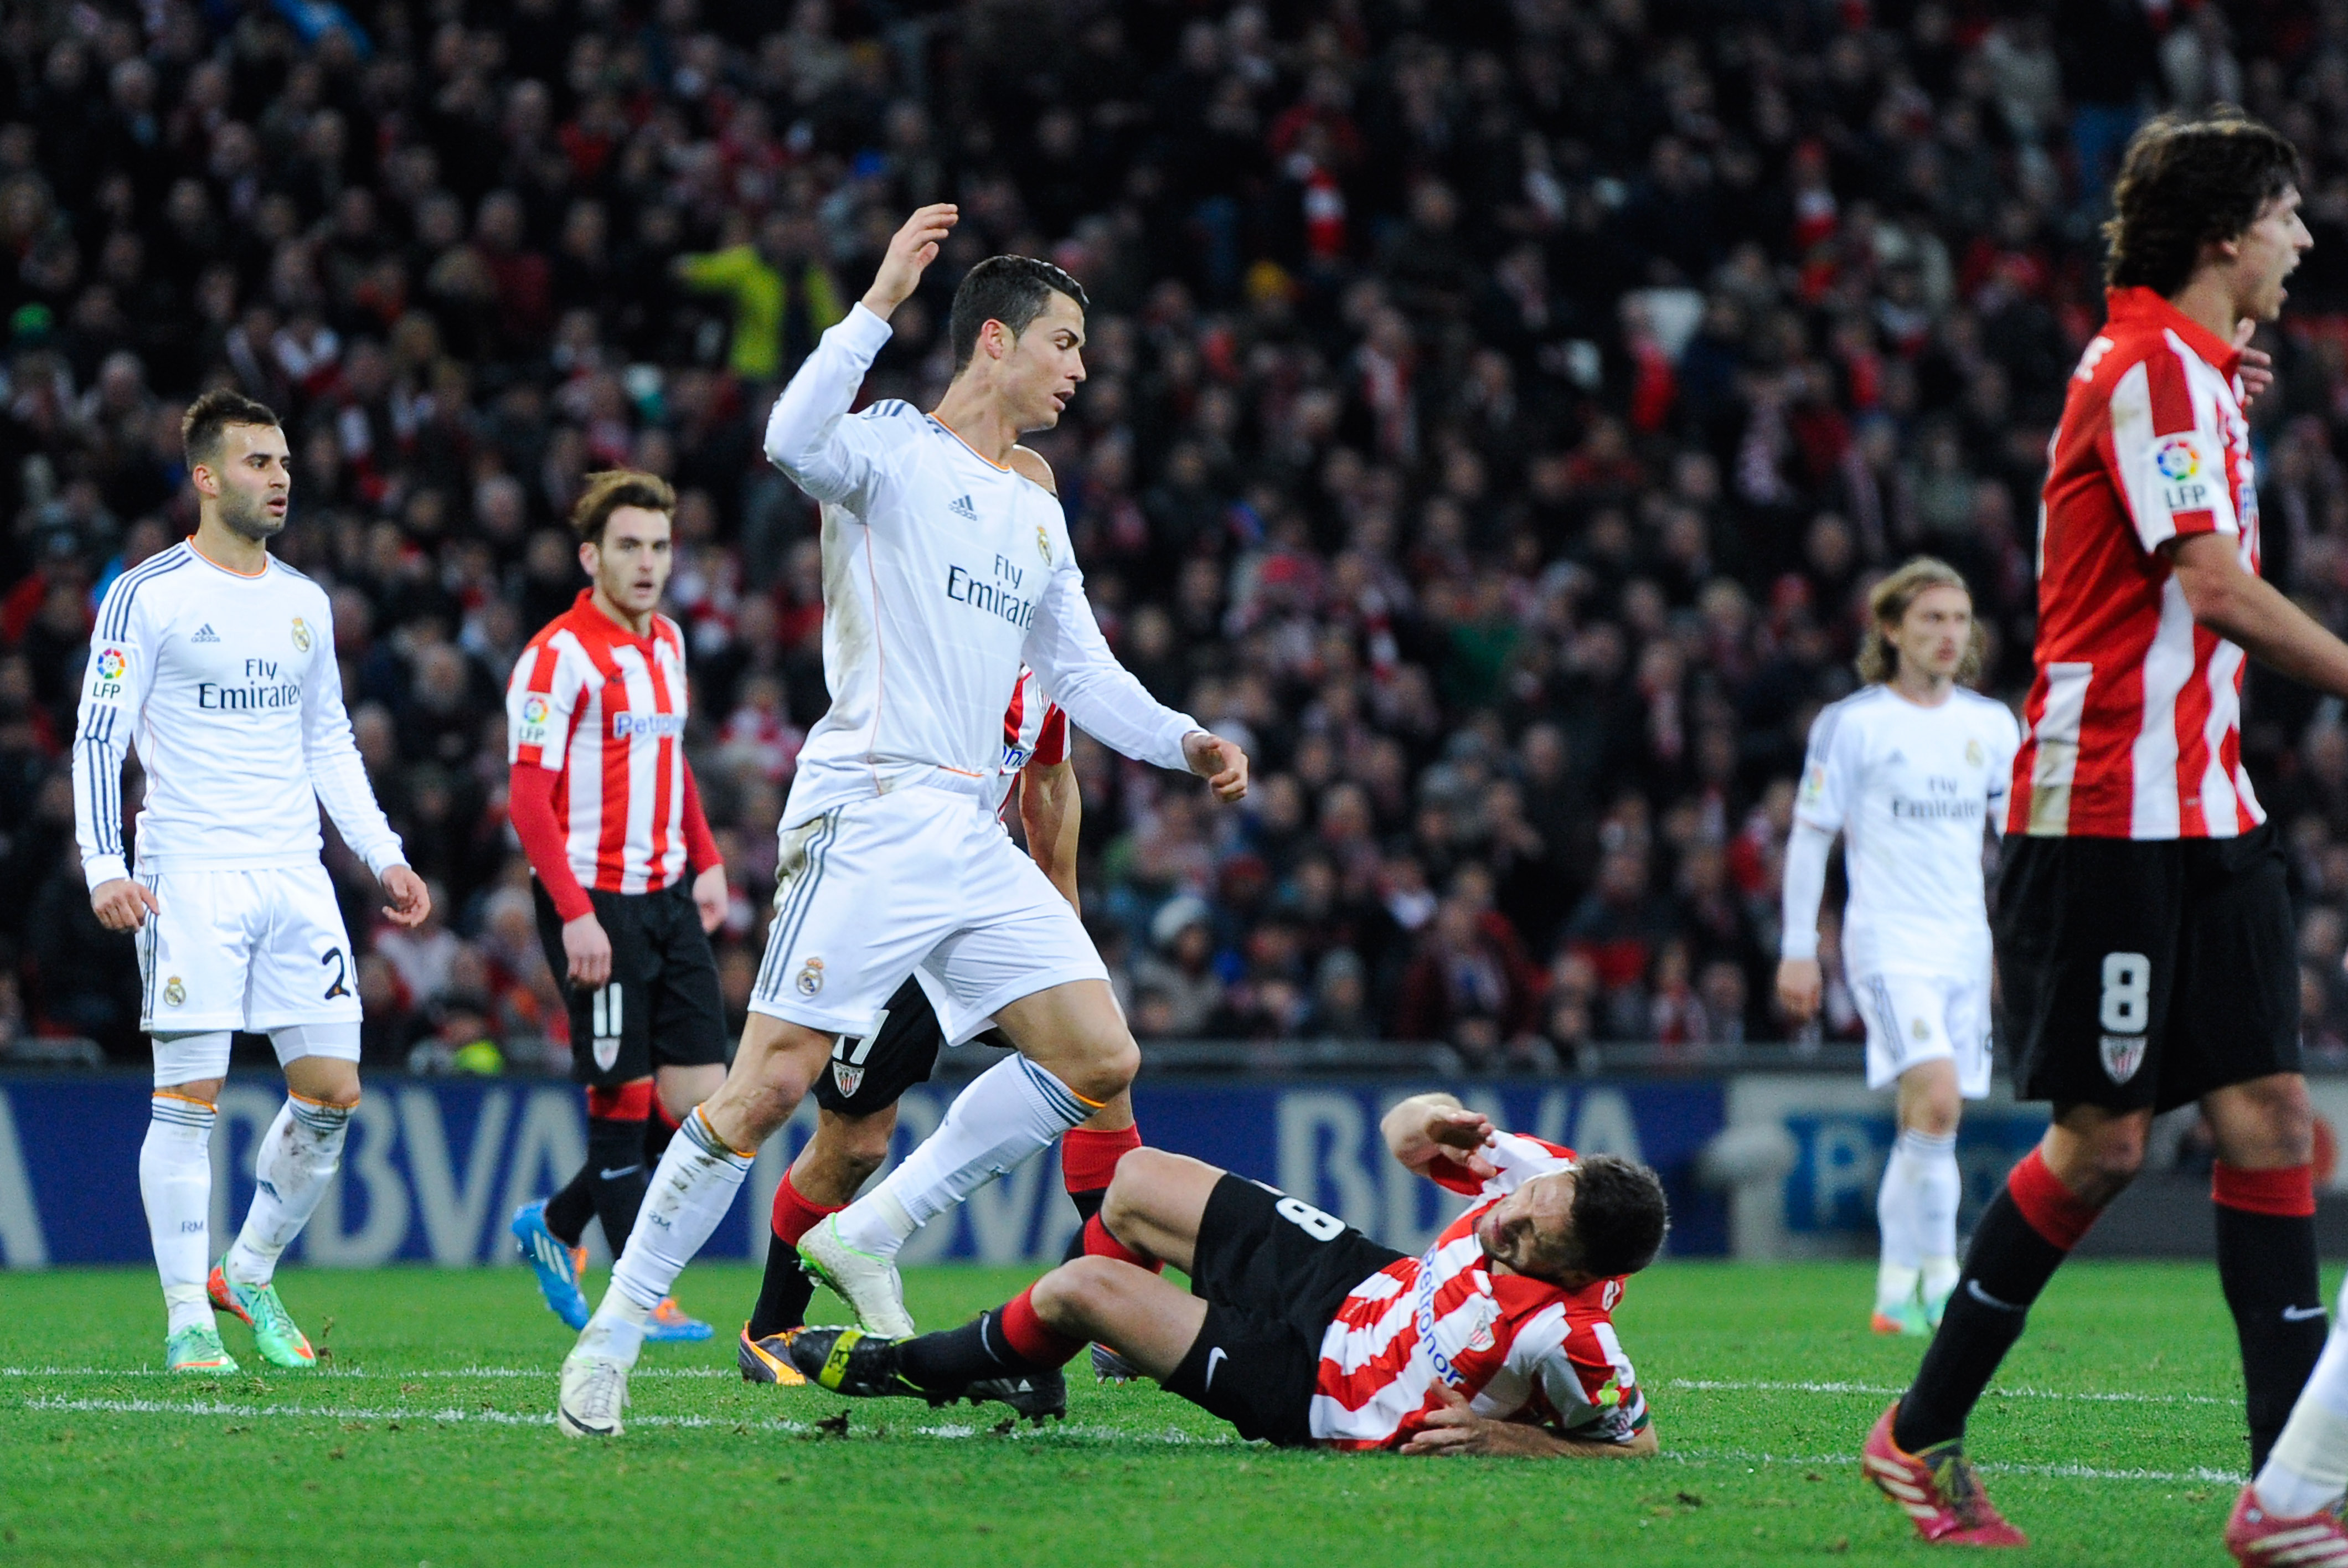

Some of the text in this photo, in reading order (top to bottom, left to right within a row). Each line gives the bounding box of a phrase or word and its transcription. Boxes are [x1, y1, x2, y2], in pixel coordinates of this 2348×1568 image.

[2165, 484, 2206, 508] LFP
[994, 553, 1023, 590] Fly
[947, 564, 1036, 631] Emirate
[245, 658, 278, 680] Fly
[92, 682, 121, 699] LFP
[198, 680, 301, 709] Emirate
[518, 726, 545, 740] LFP
[2100, 951, 2151, 1033] 8
[592, 982, 622, 1038] 11
[181, 1220, 203, 1232] RM
[1275, 1196, 1347, 1242] 8
[1420, 1247, 1466, 1384] Petronor
